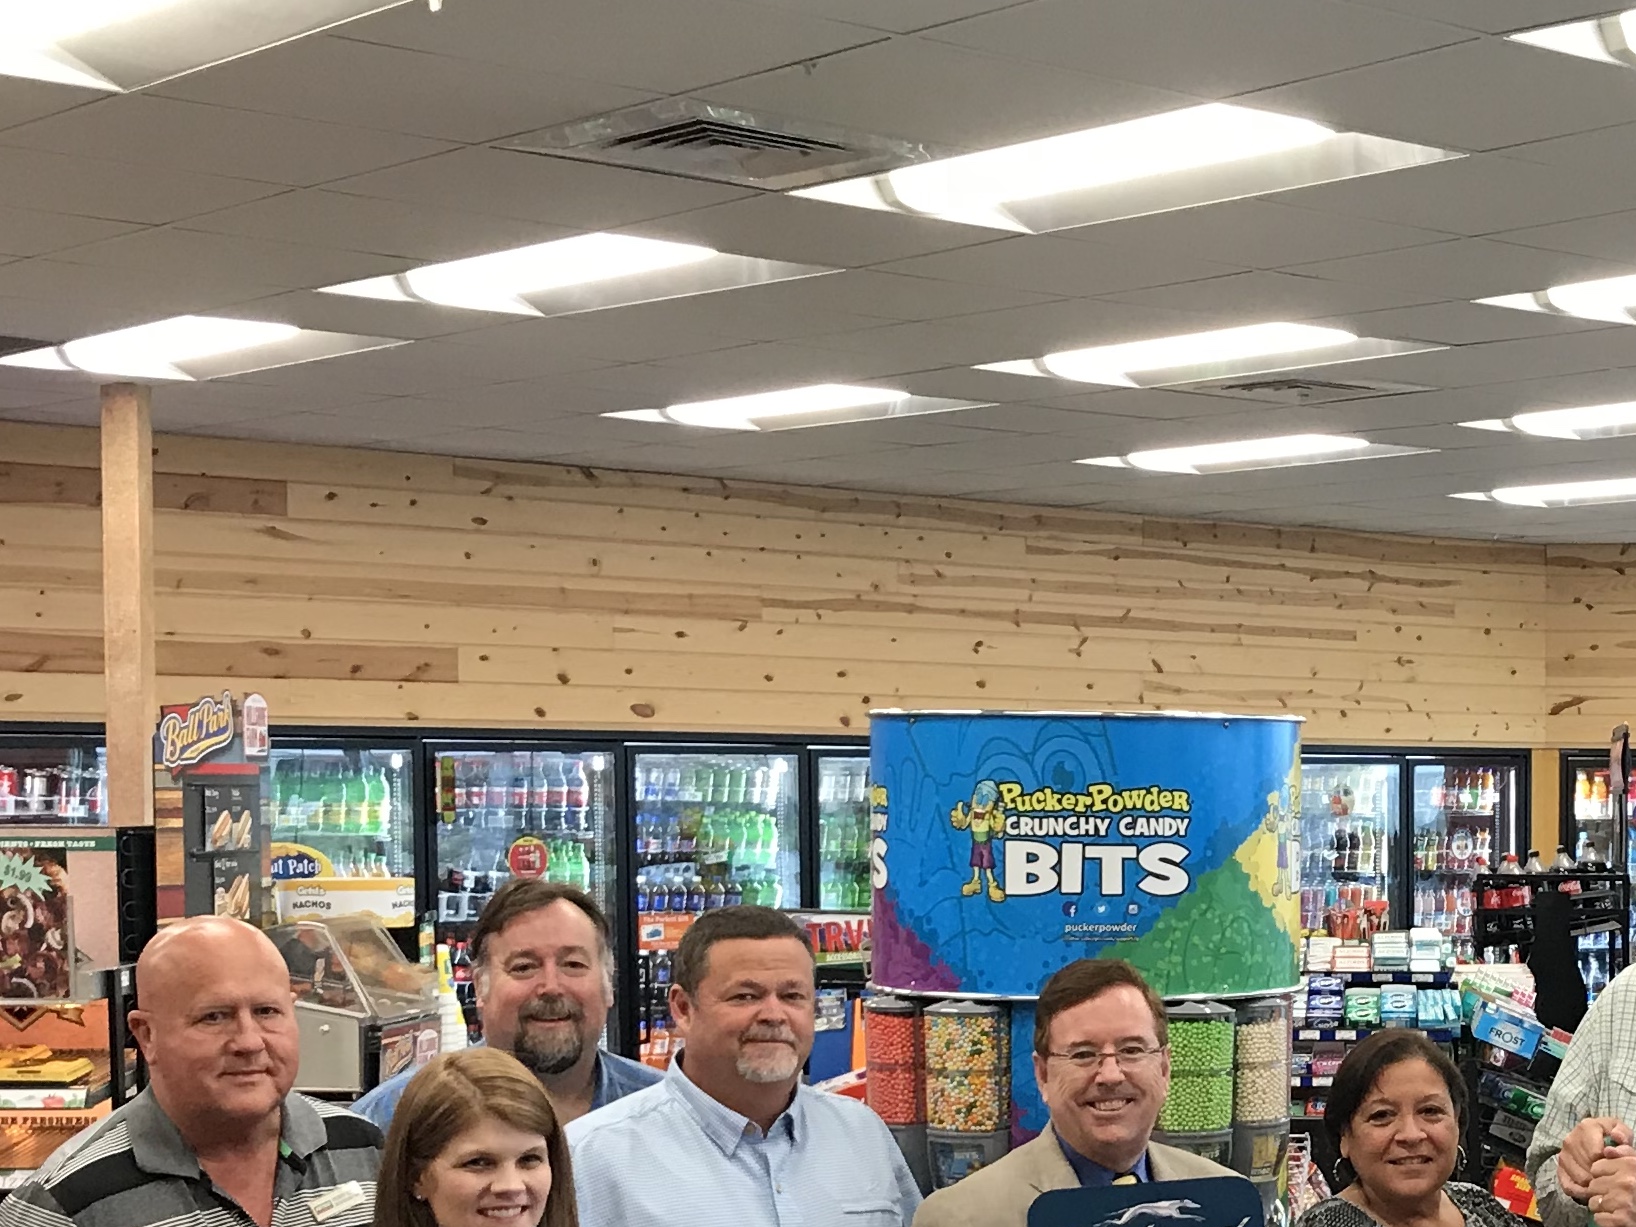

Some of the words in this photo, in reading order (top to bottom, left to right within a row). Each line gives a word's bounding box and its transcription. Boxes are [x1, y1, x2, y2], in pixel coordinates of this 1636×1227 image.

[163, 714, 200, 761] Ball
[199, 694, 231, 740] Park
[1005, 815, 1112, 837] CRUNCHY
[1118, 816, 1190, 837] CANDY
[287, 857, 322, 875] Patch
[1004, 840, 1191, 896] BITS
[292, 900, 332, 910] NACHOS
[805, 919, 873, 954] TRV
[1064, 922, 1138, 933] puckerpowder
[1488, 1027, 1527, 1047] FROST
